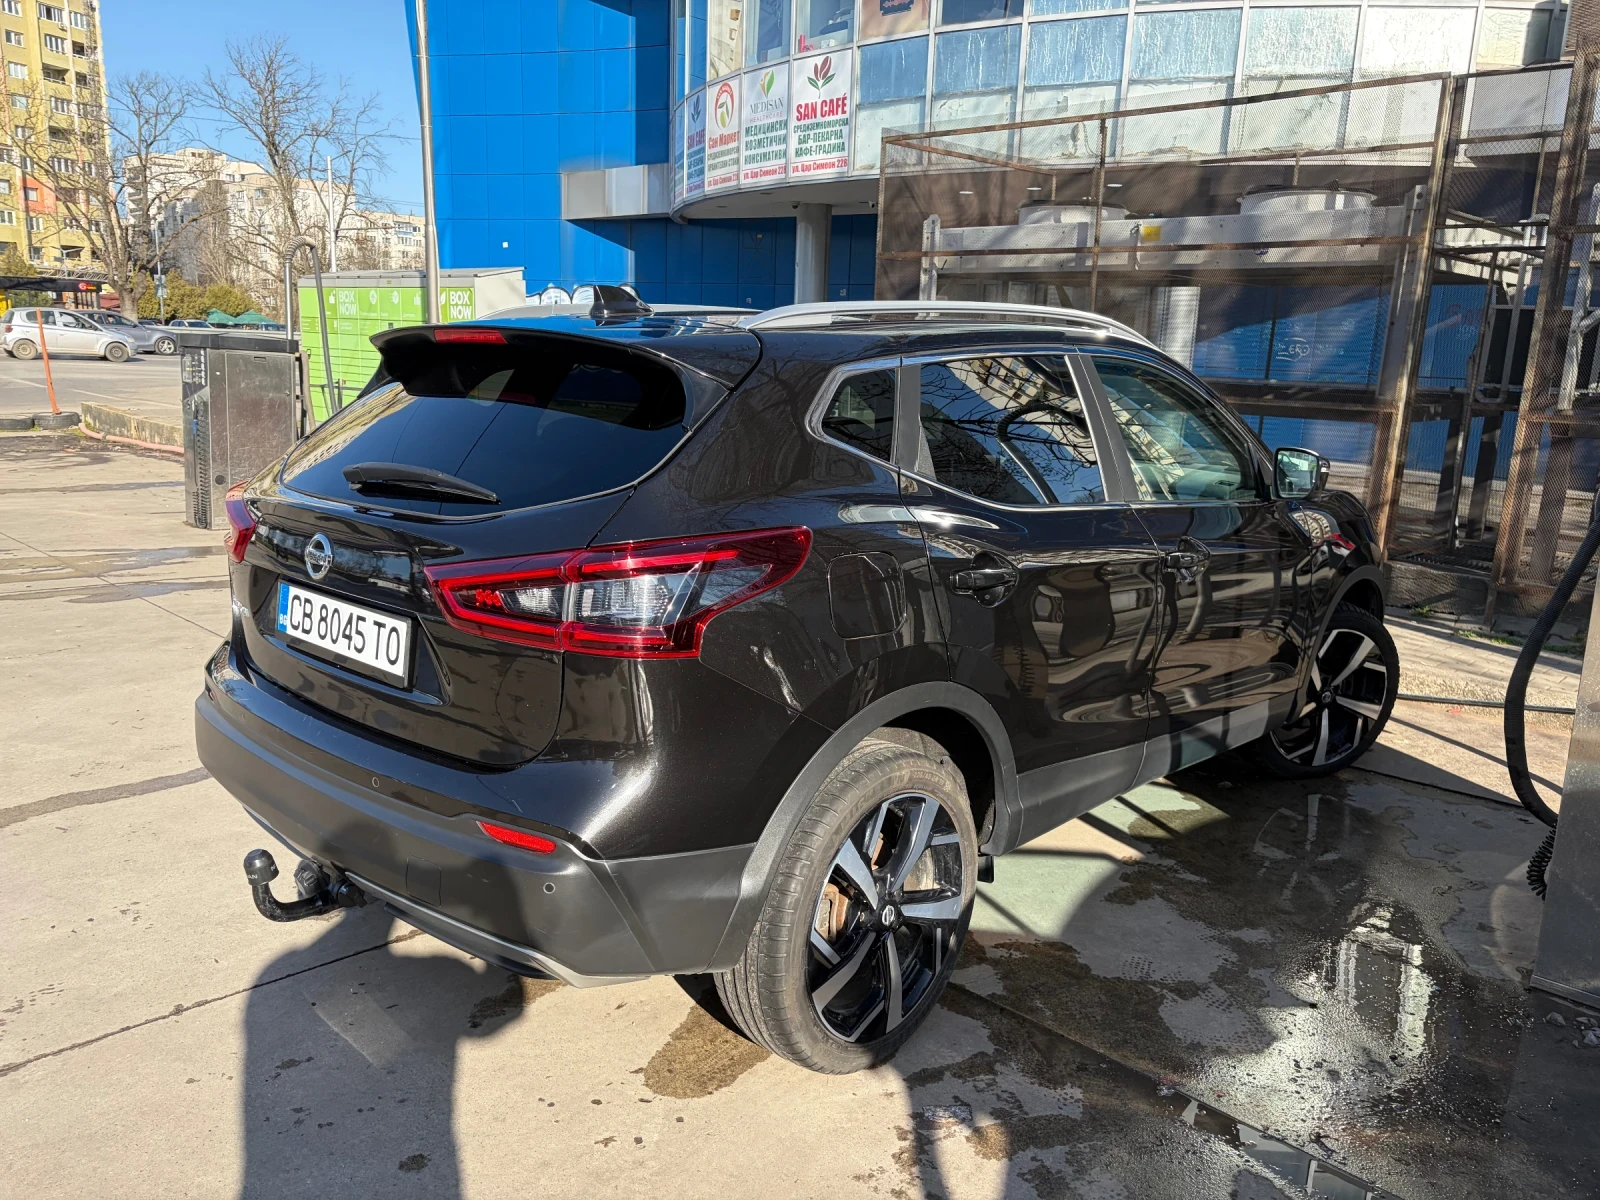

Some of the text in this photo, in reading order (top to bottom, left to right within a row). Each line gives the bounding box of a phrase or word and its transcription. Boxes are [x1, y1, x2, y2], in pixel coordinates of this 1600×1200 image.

[750, 96, 784, 115] MEDISAN
[796, 93, 847, 122] SAN CAFÉ
[794, 118, 848, 134] СРЕДИЗЕМНОМОРСКА
[798, 129, 843, 145] БАР-ПЕКАРНА
[795, 142, 846, 158] КАФЕ-ГРАДИНА
[792, 158, 848, 174] ул. Цар Симеон 228
[338, 290, 354, 302] BOX
[450, 290, 470, 304] BOX
[340, 304, 356, 316] NOW
[450, 306, 472, 320] NOW
[280, 614, 287, 626] BG
[290, 594, 314, 635] CB
[318, 604, 366, 654] 8045
